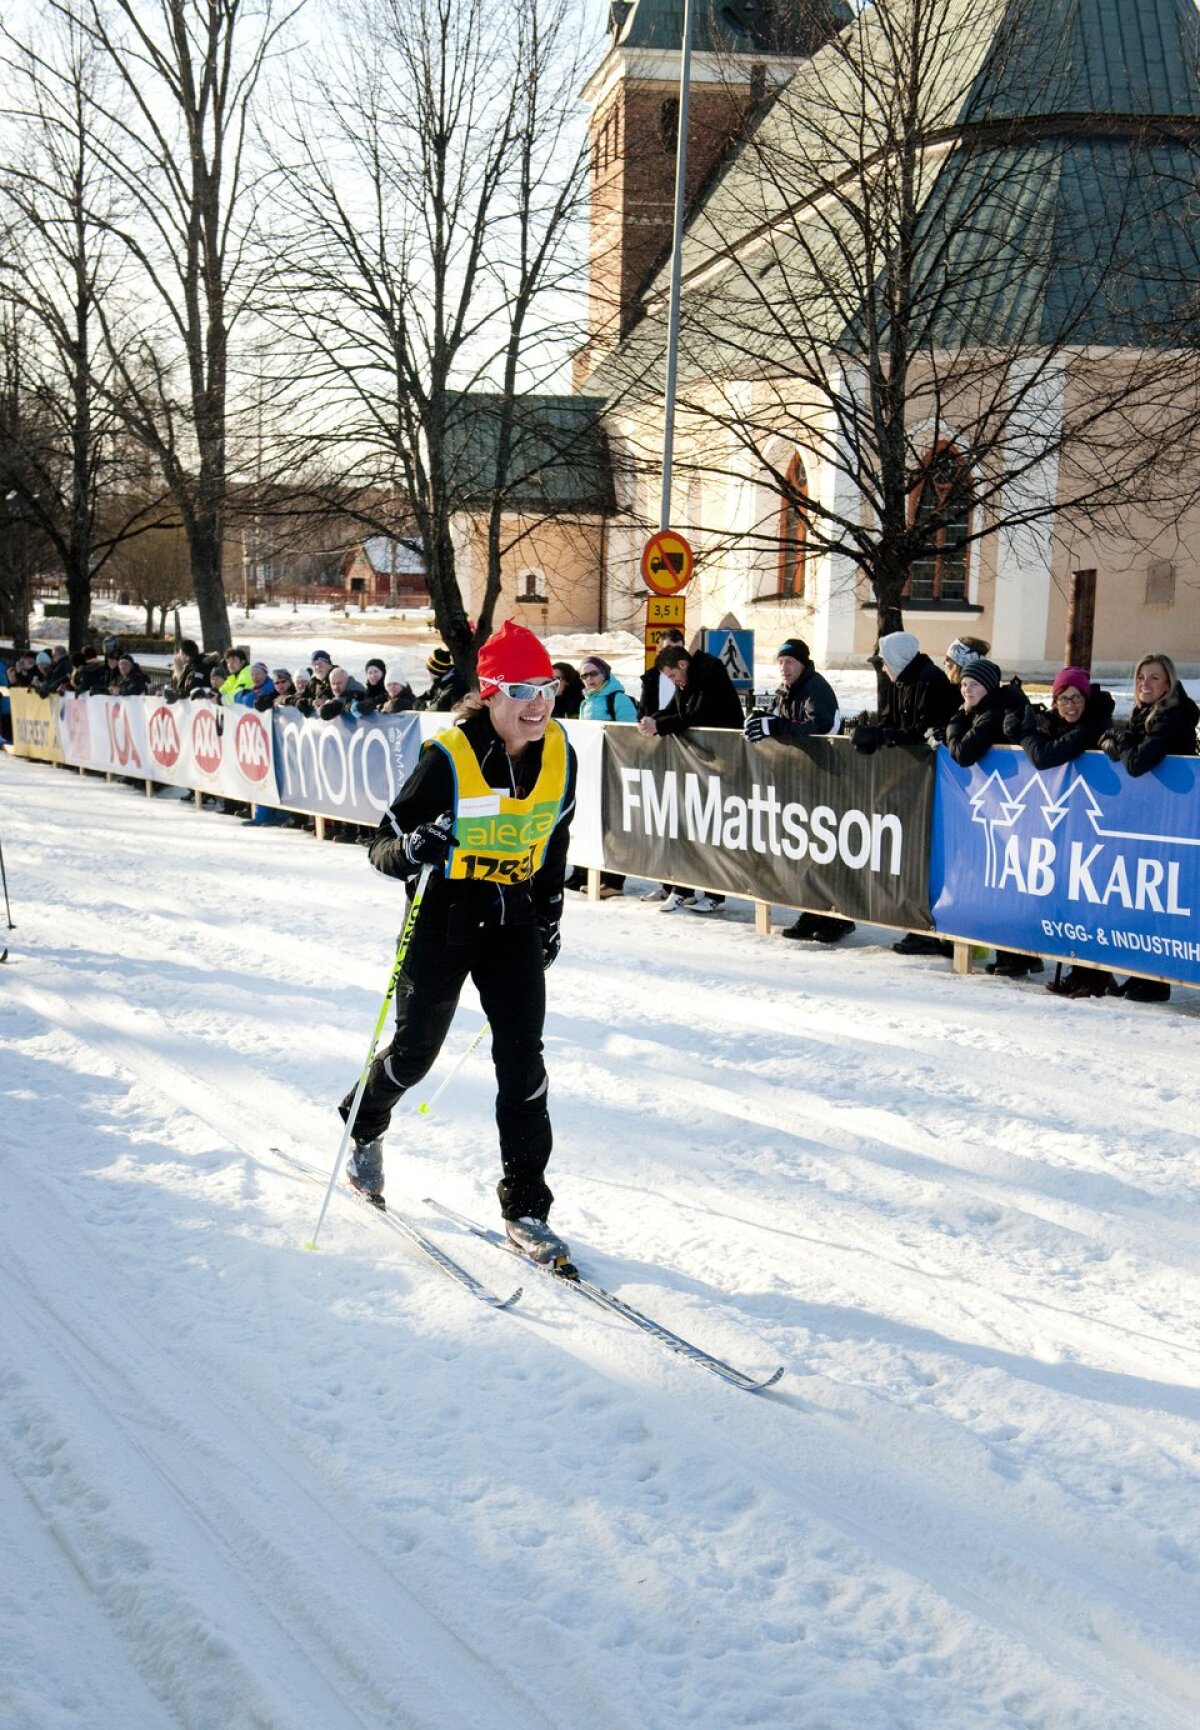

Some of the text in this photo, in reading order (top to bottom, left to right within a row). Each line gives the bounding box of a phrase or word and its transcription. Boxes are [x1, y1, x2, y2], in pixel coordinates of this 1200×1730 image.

[655, 605, 679, 618] 3,5 t
[105, 702, 142, 769] ICA
[153, 713, 179, 753] AXA
[195, 716, 221, 760] AXA
[240, 720, 269, 767] AXA
[621, 767, 903, 876] FM Mattsson
[999, 834, 1191, 916] AB KARL
[1041, 919, 1093, 942] BYGG-
[1097, 928, 1109, 946] &
